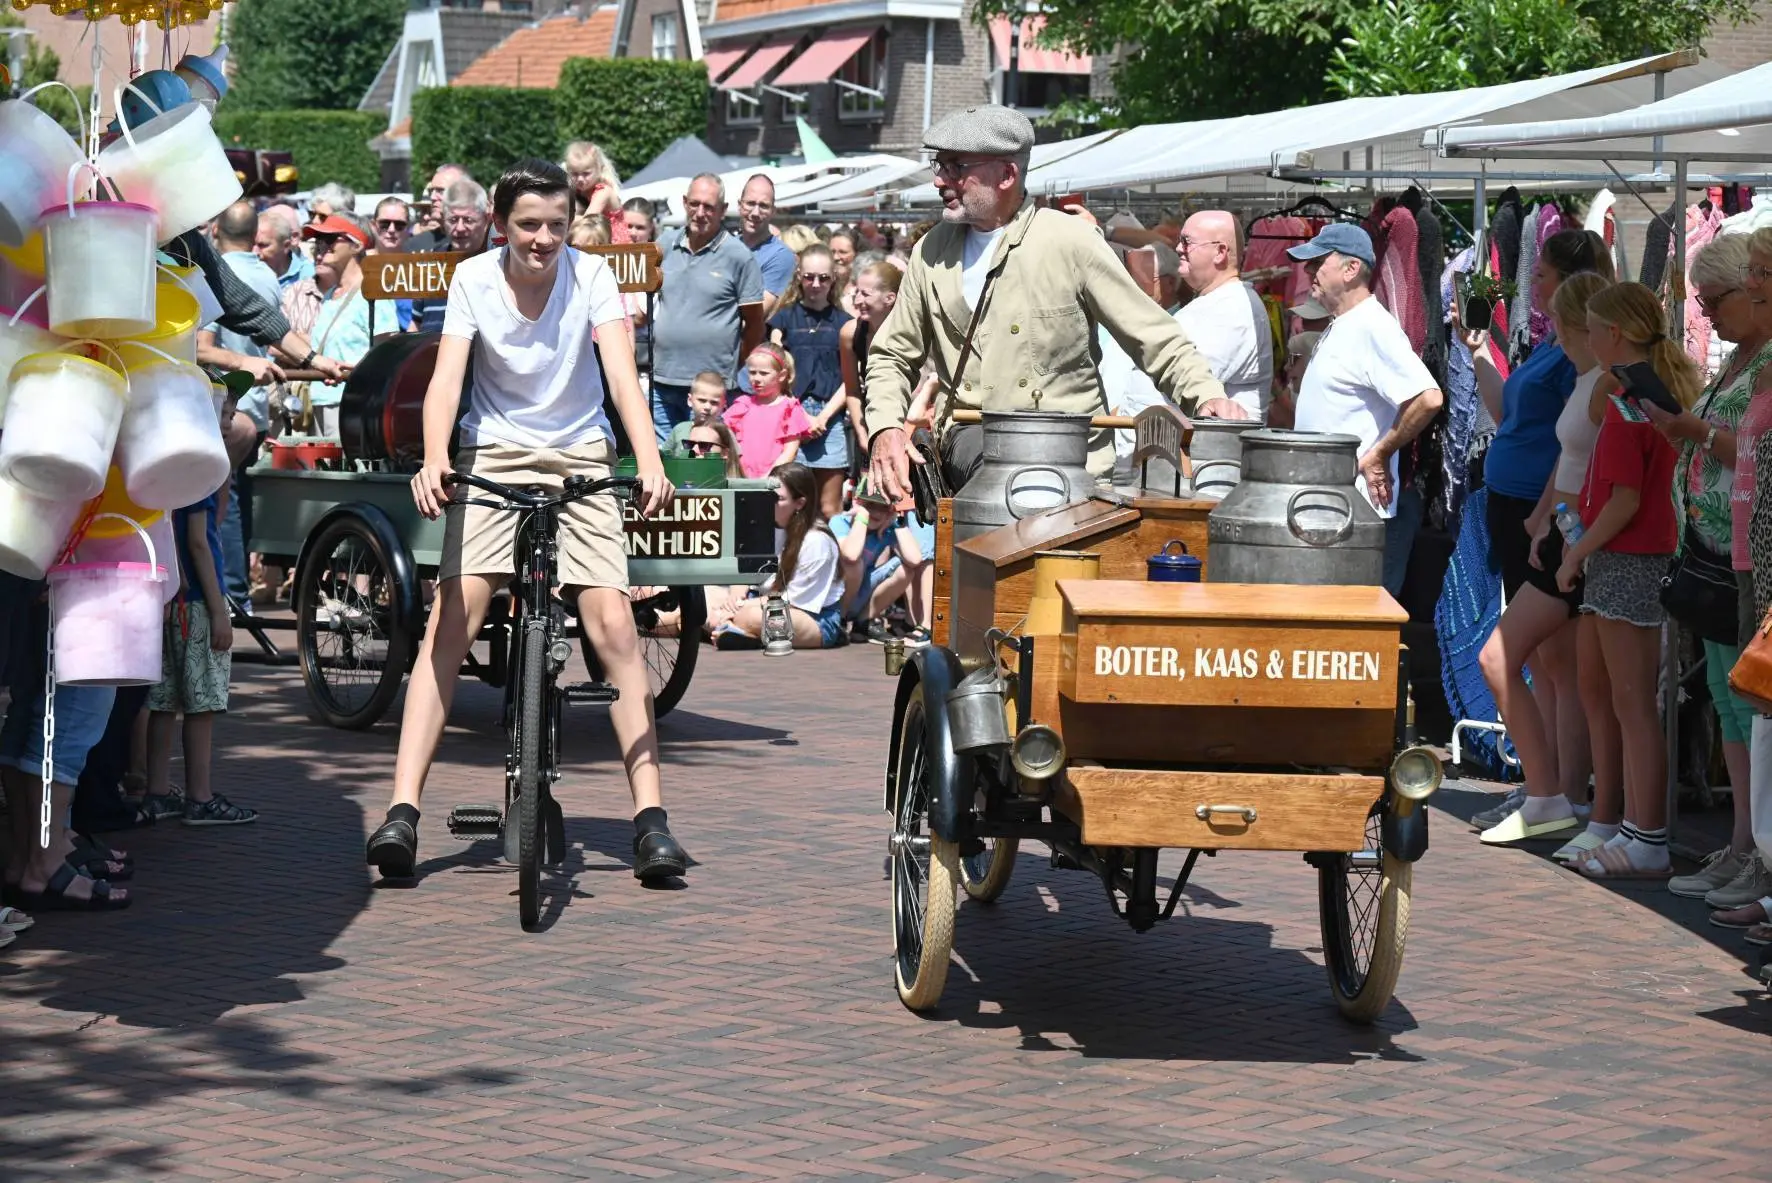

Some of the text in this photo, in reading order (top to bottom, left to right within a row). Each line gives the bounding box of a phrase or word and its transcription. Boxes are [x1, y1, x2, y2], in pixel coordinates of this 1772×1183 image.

[381, 261, 448, 293] CALTEX
[658, 530, 720, 556] HUIS
[1095, 646, 1380, 681] BOTER, KAAS & EIEREN
